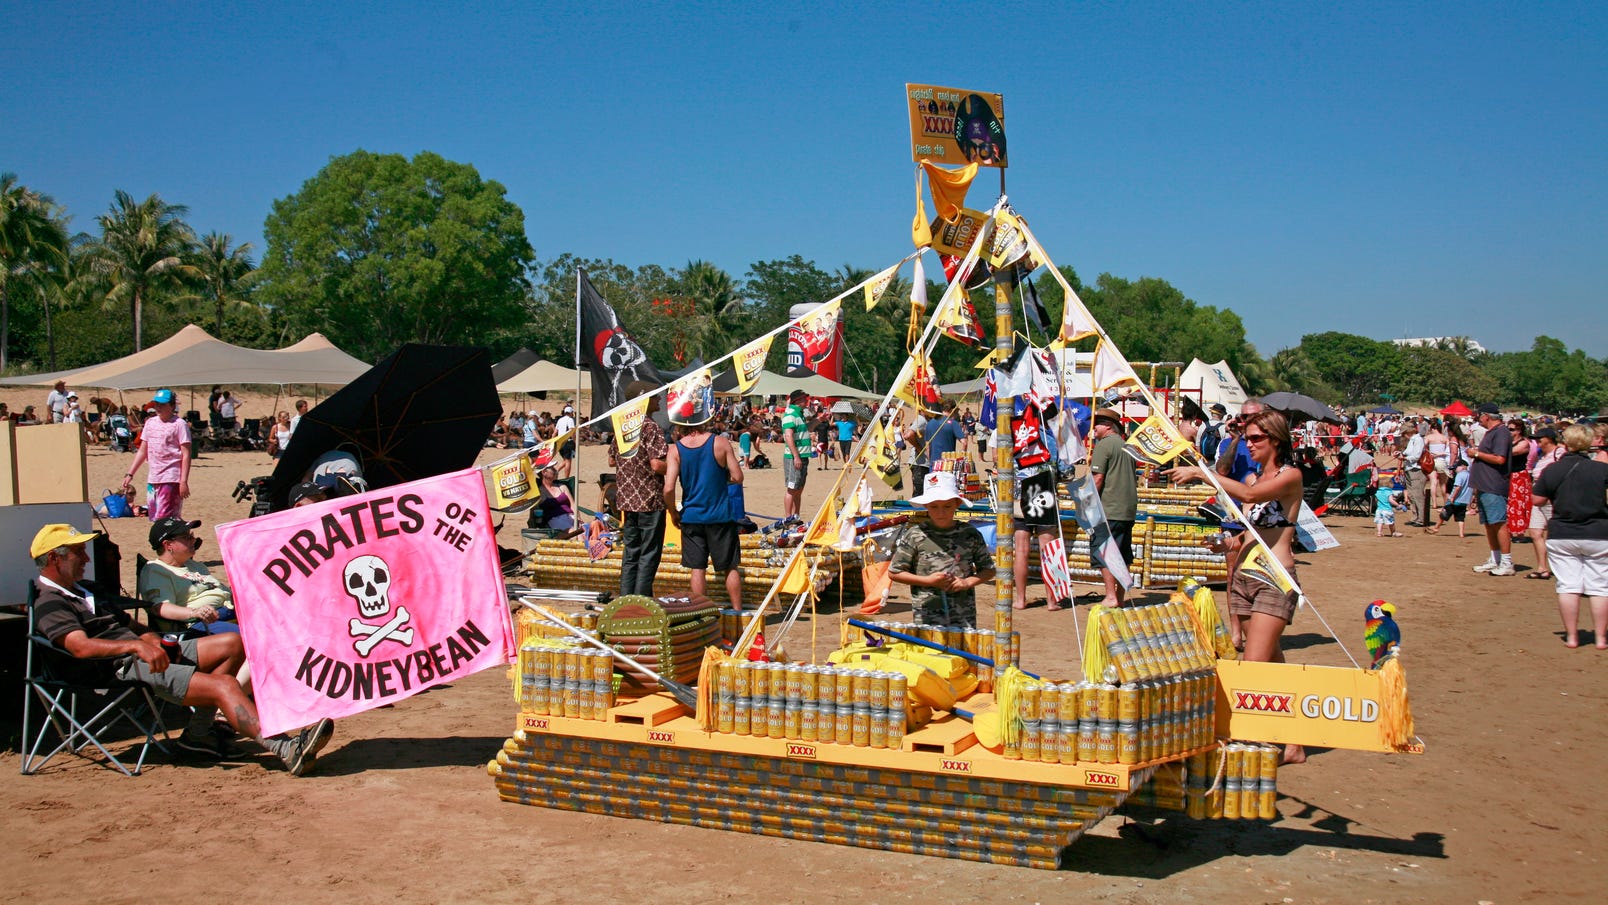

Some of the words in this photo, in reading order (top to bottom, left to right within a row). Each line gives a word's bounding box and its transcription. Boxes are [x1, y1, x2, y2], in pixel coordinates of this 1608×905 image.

[955, 217, 974, 248] GOLD
[621, 414, 646, 432] GOLD
[1145, 426, 1174, 450] GOLD
[503, 466, 518, 475] XXXX
[500, 472, 526, 487] GOLD
[433, 518, 473, 553] THE
[262, 494, 425, 597] PIRATES
[445, 502, 477, 526] OF
[294, 619, 491, 701] KIDNEYBEAN
[1236, 692, 1291, 712] XXXX
[1301, 694, 1379, 722] GOLD
[525, 718, 548, 729] XXXX
[649, 732, 673, 742] XXXX
[789, 746, 814, 756] XXXX
[942, 760, 969, 771] XXXX
[1089, 773, 1118, 785] XXXX
